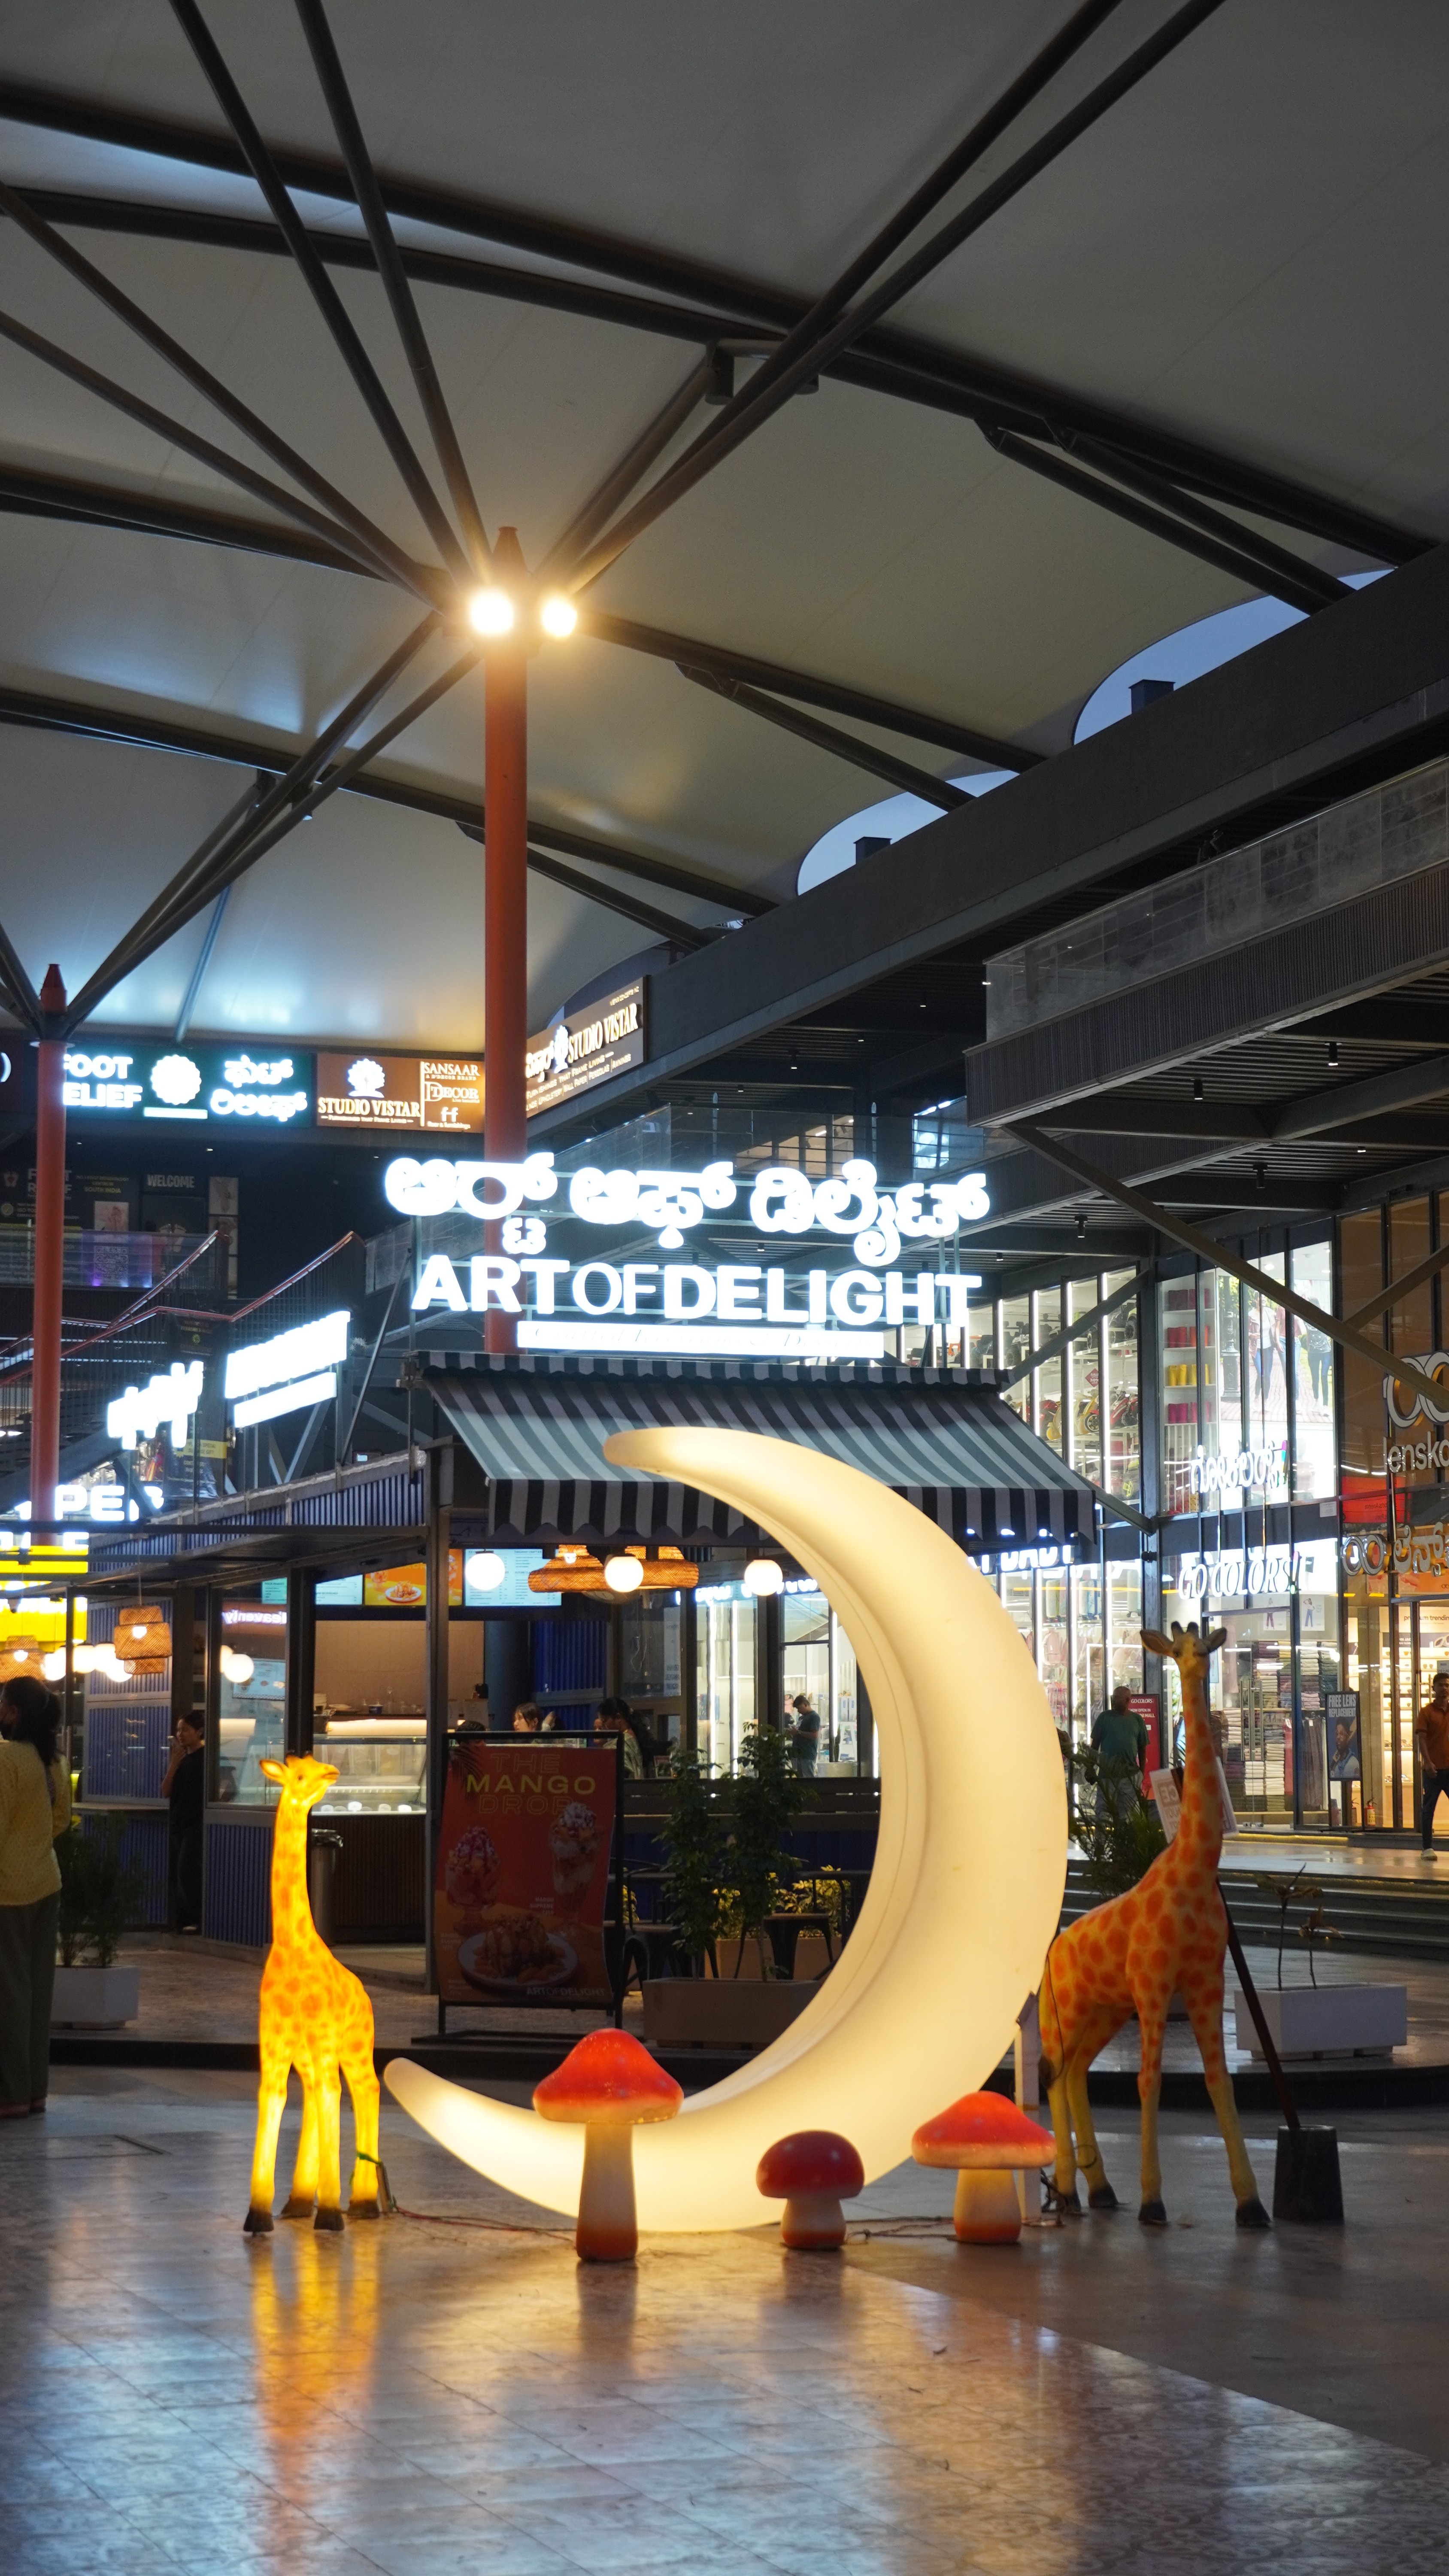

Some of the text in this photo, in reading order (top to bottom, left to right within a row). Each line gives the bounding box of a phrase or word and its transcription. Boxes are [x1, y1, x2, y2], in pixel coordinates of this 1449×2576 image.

[568, 1003, 638, 1063] STUDIO VISTAR
[424, 1062, 481, 1076] SANSAAR
[559, 1072, 571, 1083] THAT
[571, 1063, 588, 1077] FRAME
[588, 1055, 605, 1069] LIVING
[63, 1082, 142, 1108] ELIEF
[318, 1097, 421, 1117] STUDIO VISTAR
[147, 1174, 195, 1188] WELCOME
[1179, 1564, 1207, 1600] GO
[1328, 1694, 1356, 1707] FREE LENS
[1328, 1707, 1356, 1718] REPLACEMENT
[491, 1753, 561, 1773] THE
[466, 1774, 596, 1795] MANGO
